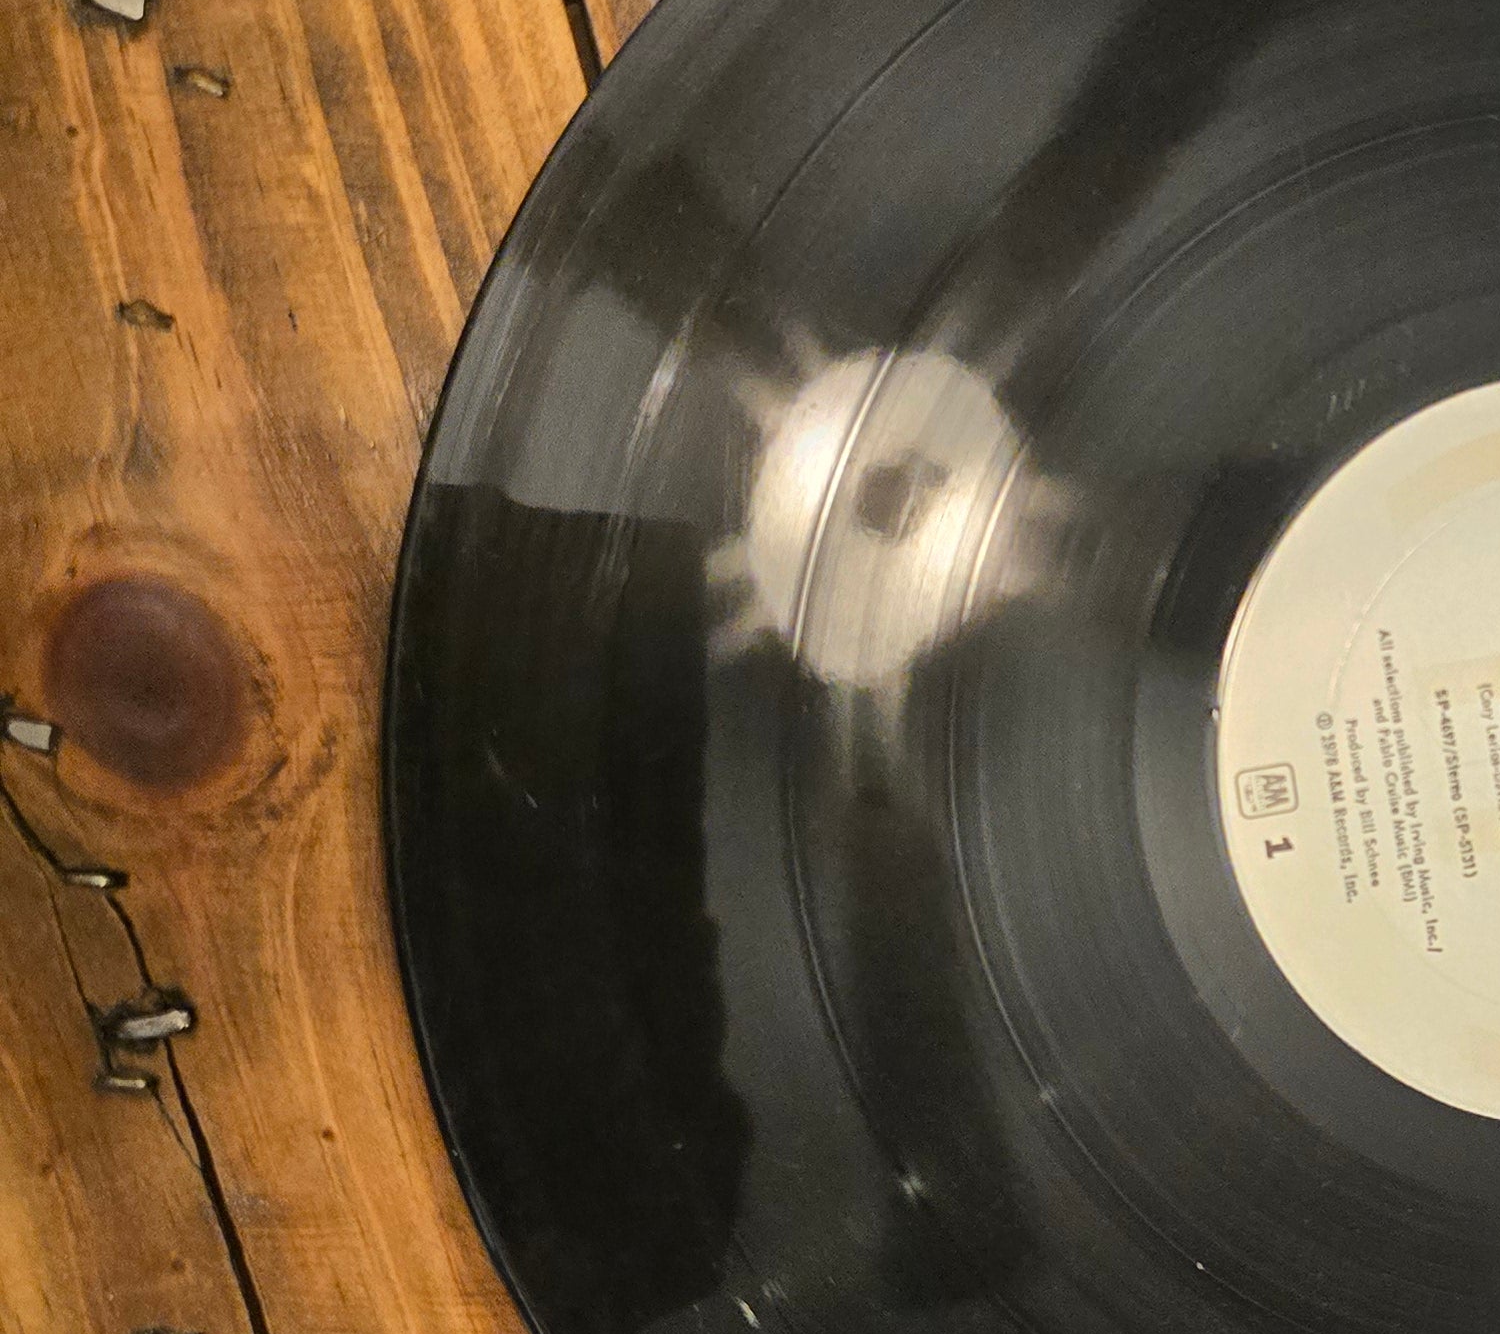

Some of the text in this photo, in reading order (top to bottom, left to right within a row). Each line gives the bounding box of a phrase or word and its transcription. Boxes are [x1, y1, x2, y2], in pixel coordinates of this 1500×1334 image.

[1373, 699, 1389, 724] and
[1378, 629, 1392, 650] All
[1392, 729, 1418, 795] published
[1407, 801, 1420, 819] by
[1346, 719, 1367, 783] Produced
[1355, 788, 1370, 805] by
[1383, 772, 1402, 815] Cruise
[1359, 811, 1376, 834] Bill
[1265, 837, 1295, 859] 1
[1390, 820, 1408, 860] Music
